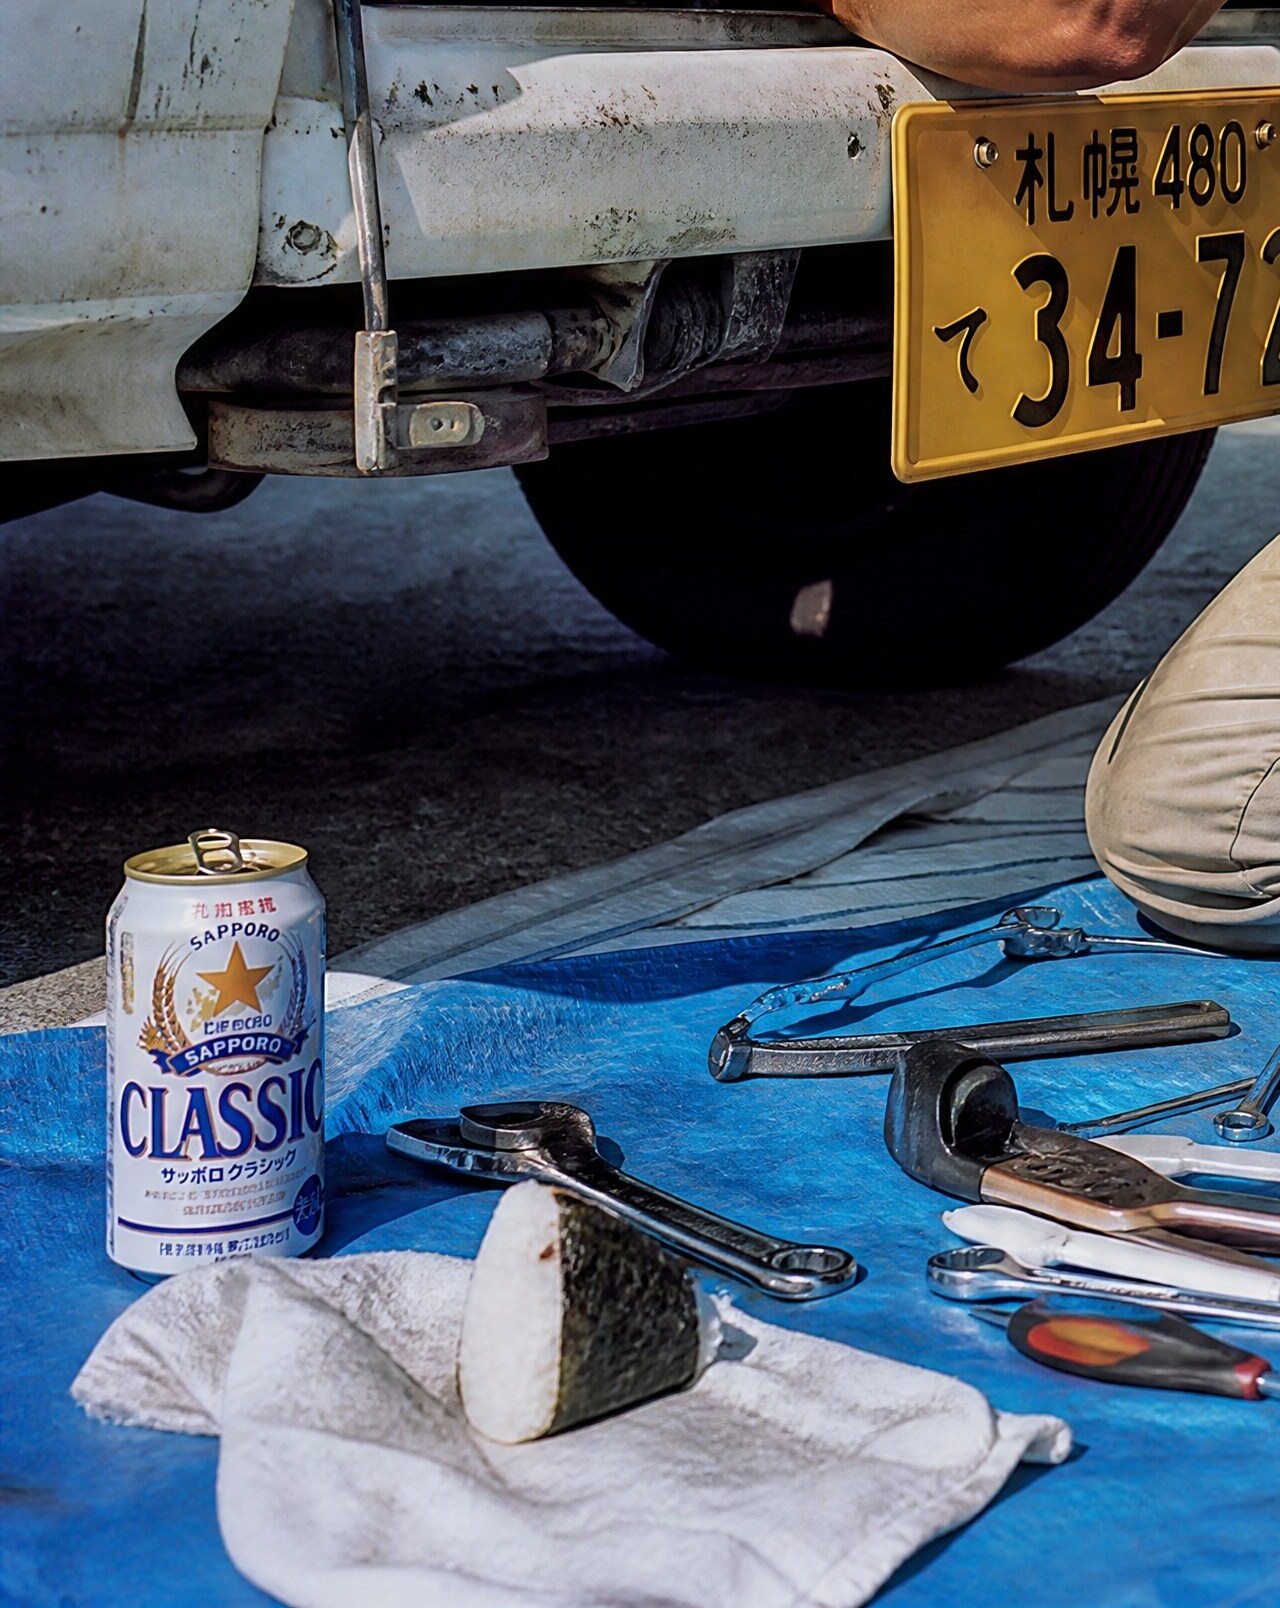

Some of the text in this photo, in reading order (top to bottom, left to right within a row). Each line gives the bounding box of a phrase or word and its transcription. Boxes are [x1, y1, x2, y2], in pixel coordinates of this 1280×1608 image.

[1013, 119, 1248, 226] 札幌 480
[933, 306, 989, 394] て
[190, 922, 281, 951] SAPPORO
[184, 1036, 282, 1066] SAPPORO
[120, 1057, 324, 1161] CLASSIC
[161, 1166, 224, 1185] サッポロ
